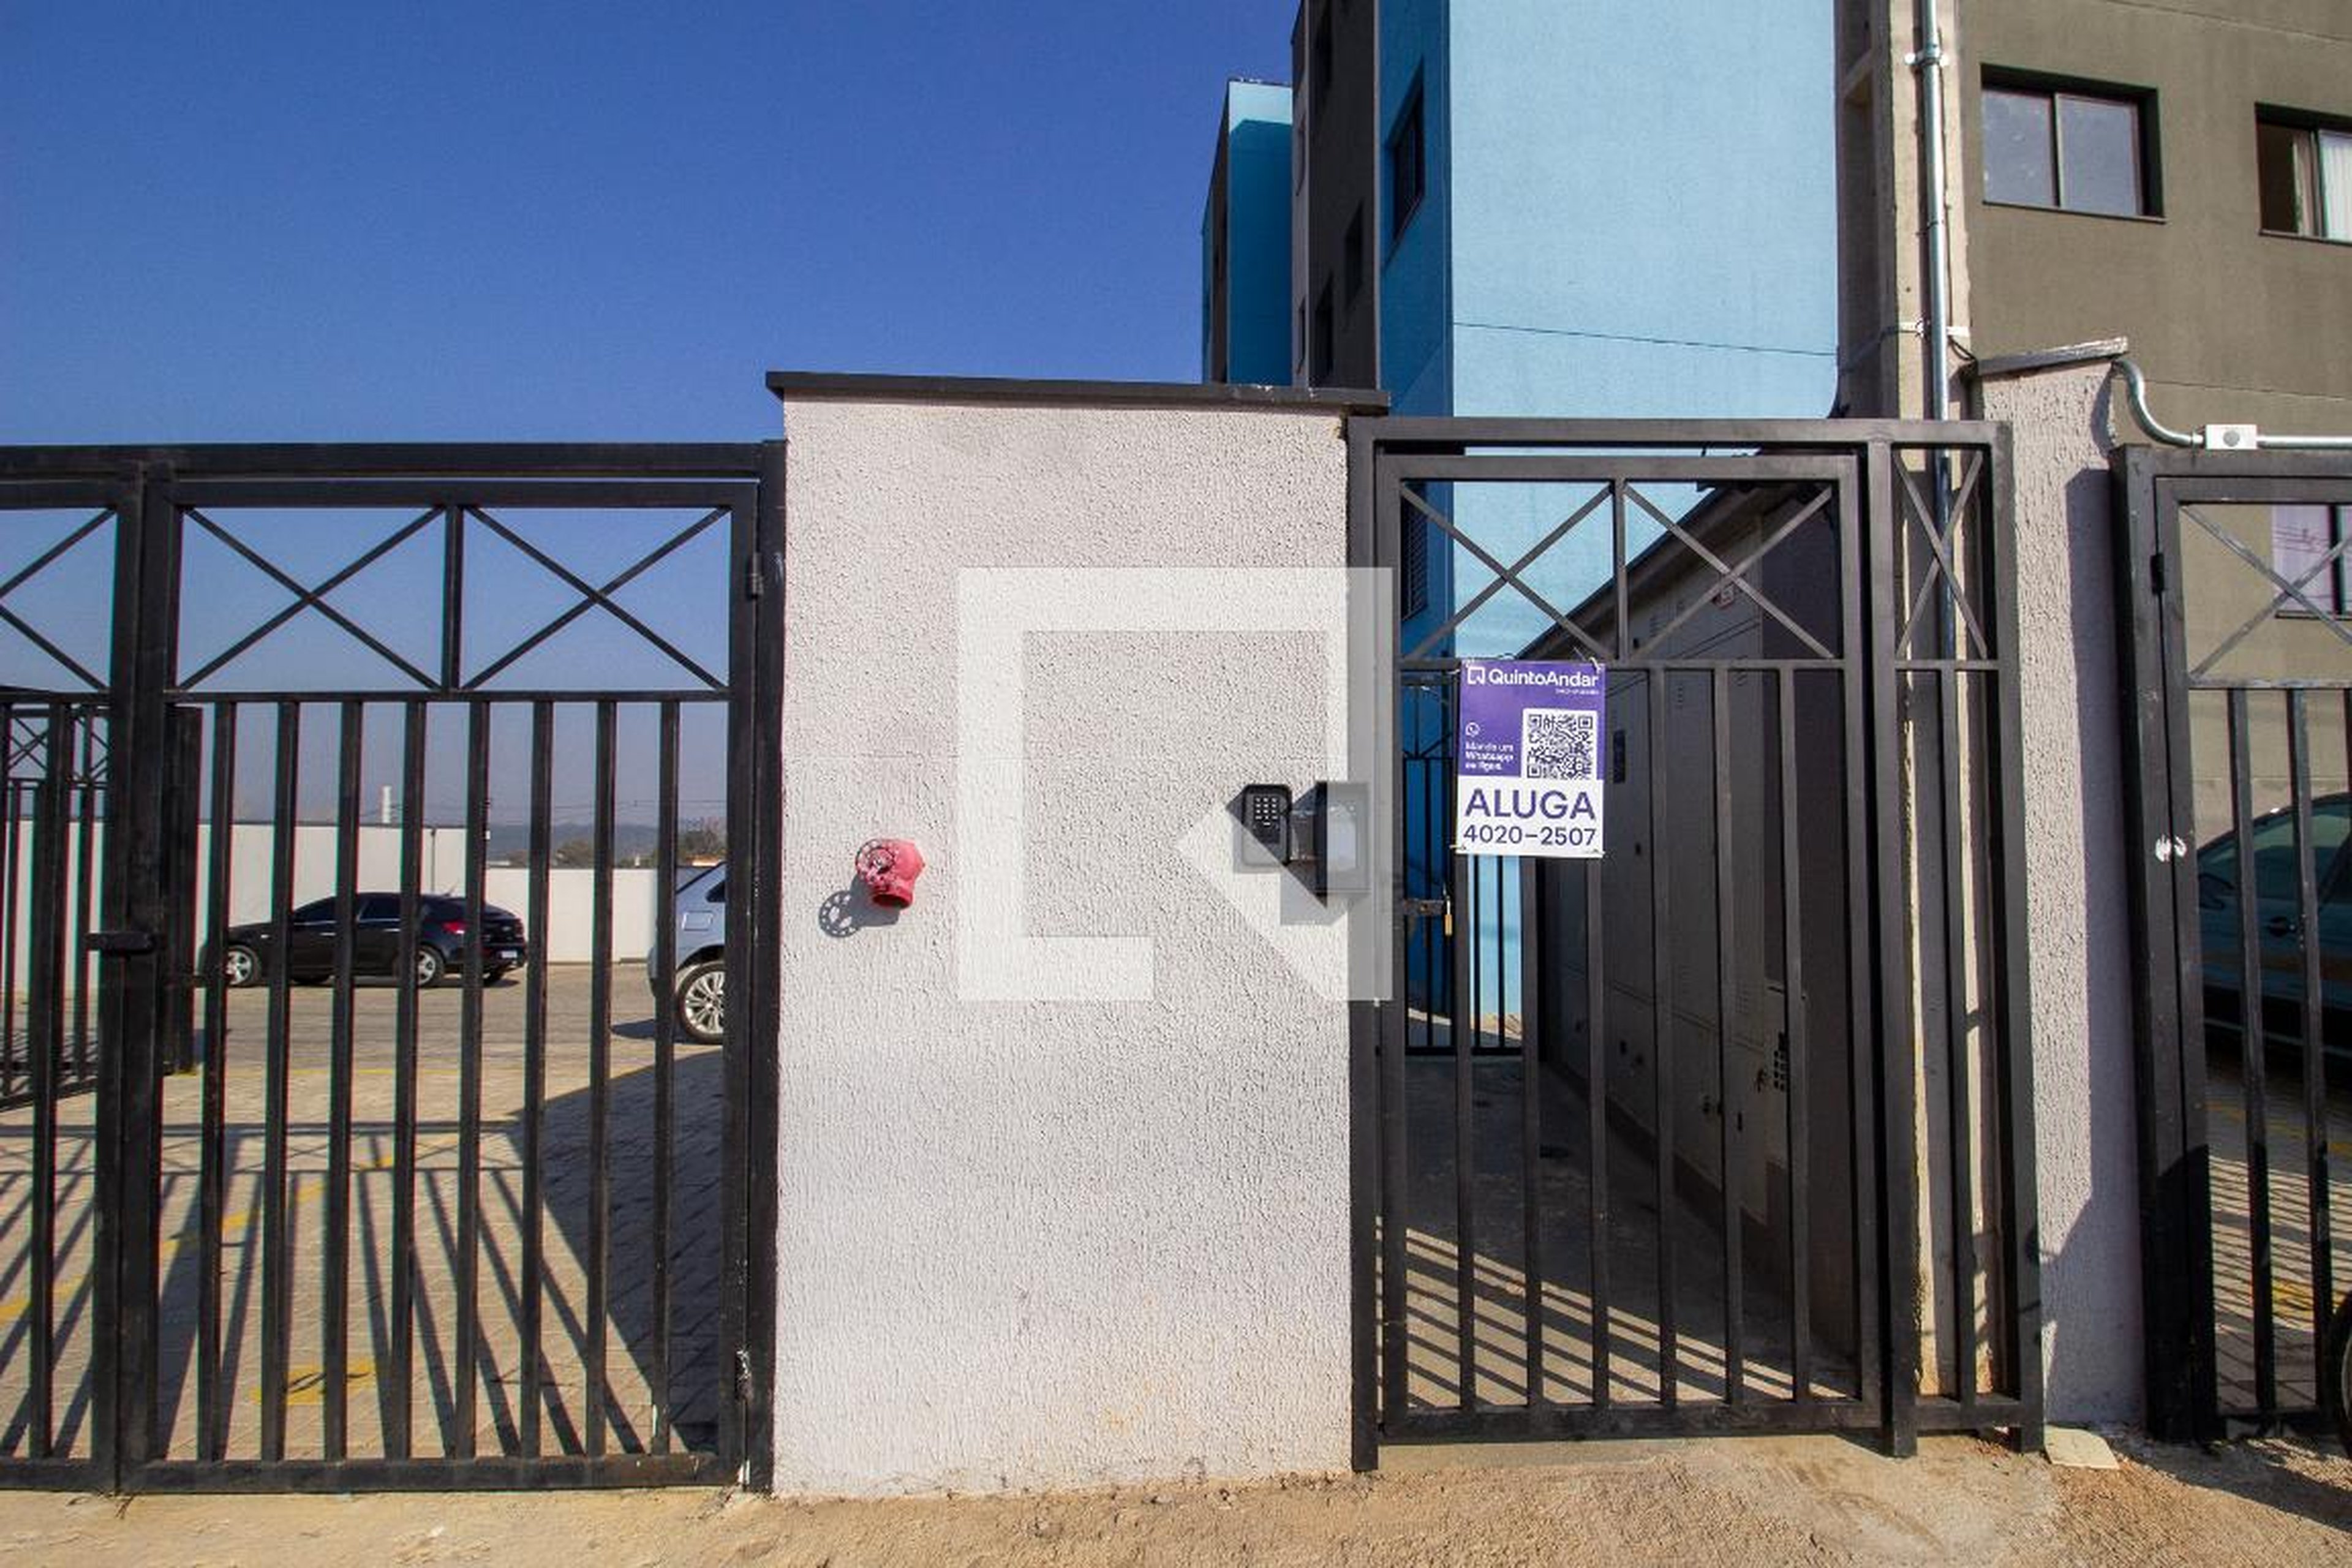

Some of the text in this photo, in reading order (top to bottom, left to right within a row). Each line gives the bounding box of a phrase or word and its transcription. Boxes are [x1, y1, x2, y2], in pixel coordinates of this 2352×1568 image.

[1489, 669, 1599, 687] QuintoAndar
[1465, 788, 1595, 820] ALUGA
[1464, 824, 1596, 846] 4020-2507
